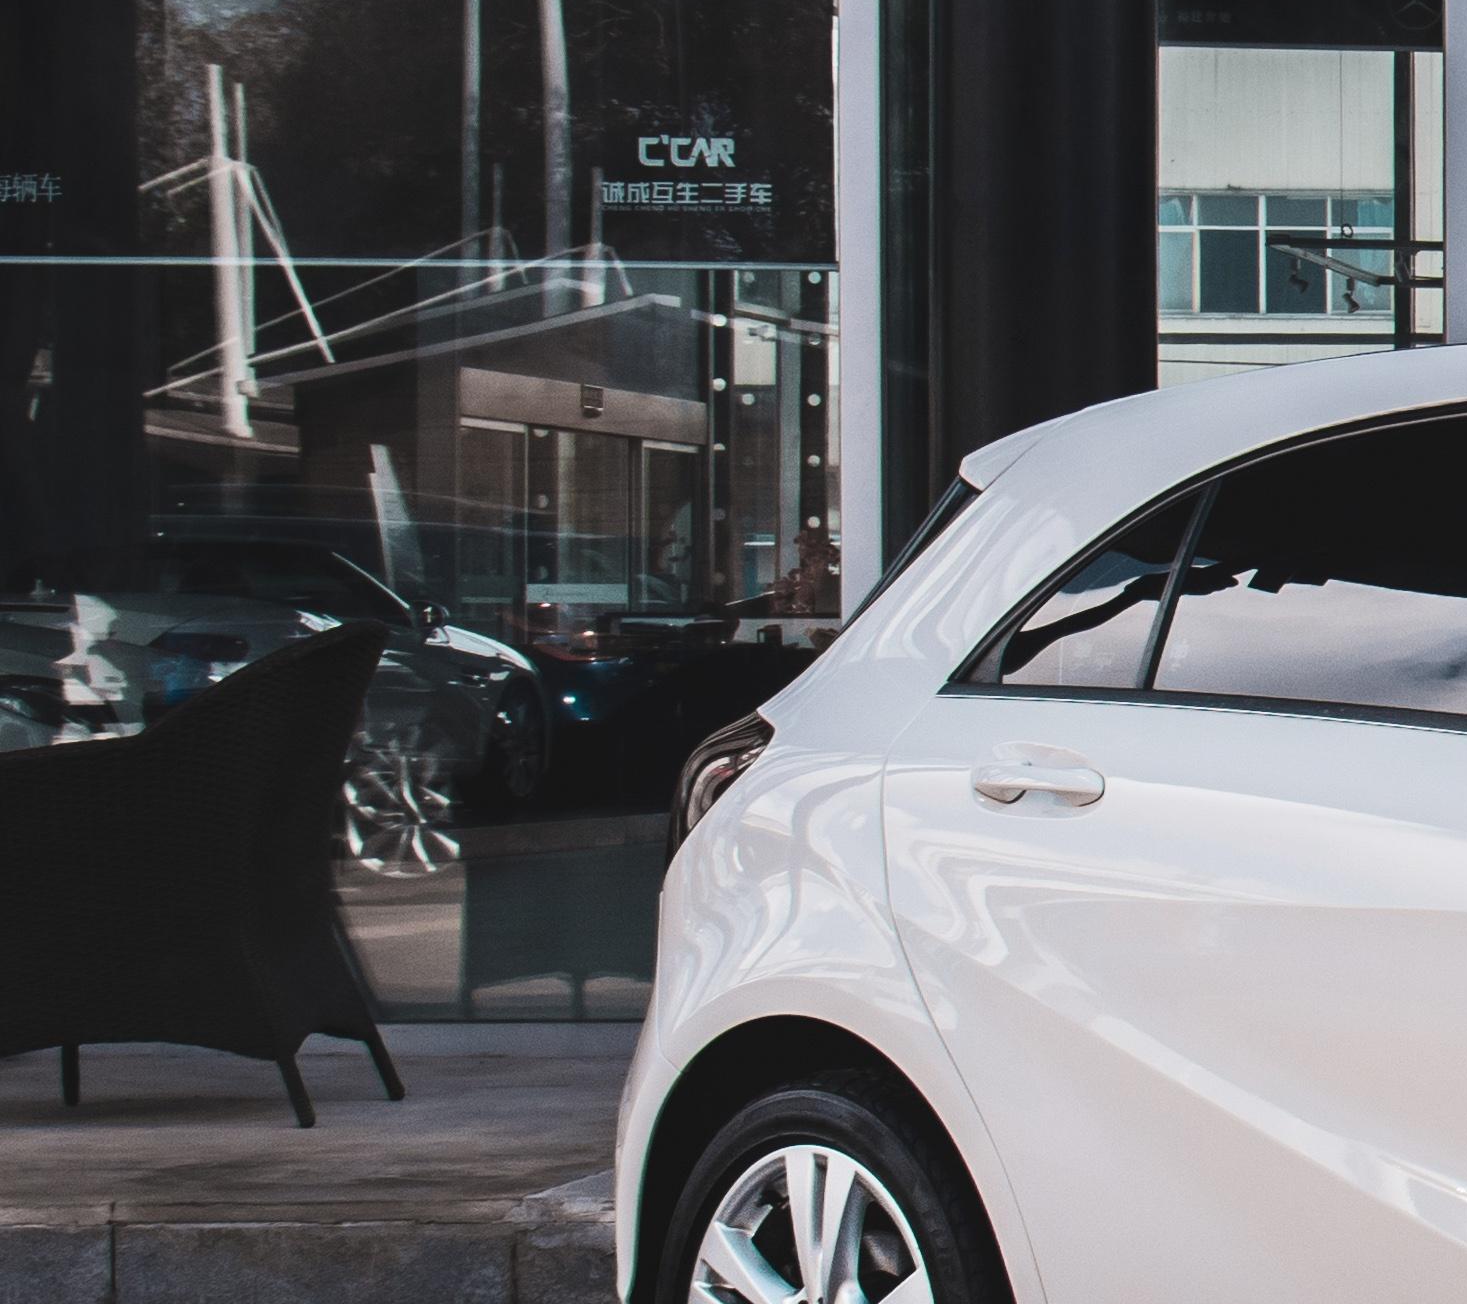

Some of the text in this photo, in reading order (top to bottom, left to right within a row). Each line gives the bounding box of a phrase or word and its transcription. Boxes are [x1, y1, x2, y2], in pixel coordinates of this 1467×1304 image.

[601, 182, 773, 204] 诚成互生二手车
